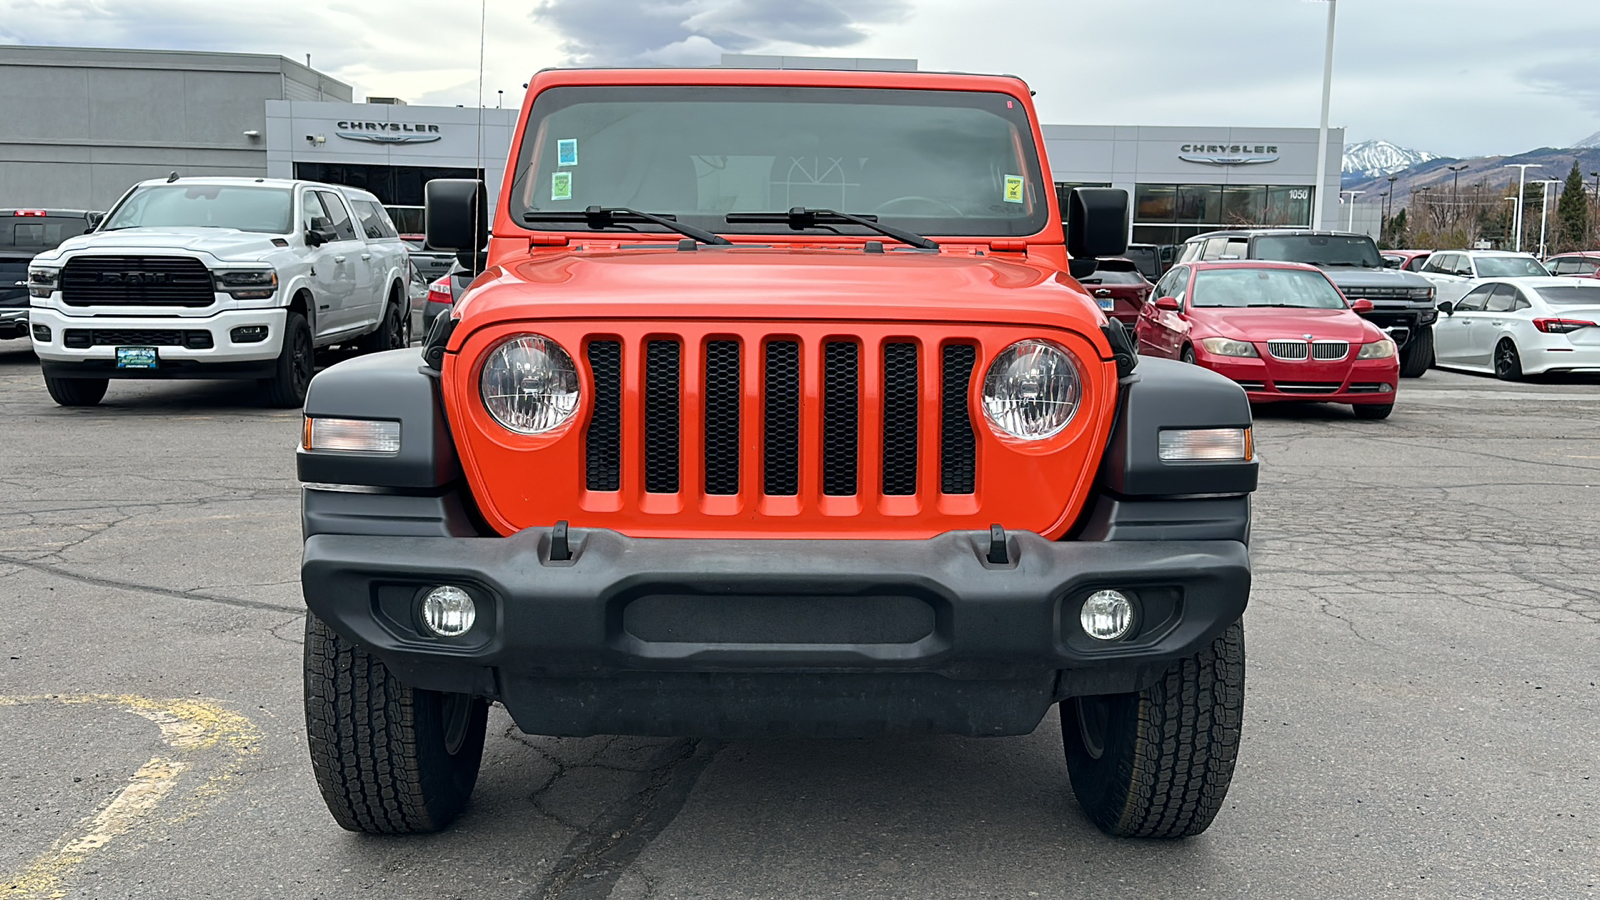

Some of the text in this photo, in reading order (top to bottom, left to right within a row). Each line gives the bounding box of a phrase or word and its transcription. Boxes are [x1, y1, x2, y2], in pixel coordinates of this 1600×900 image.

[337, 121, 440, 132] CHRYSLER
[1180, 144, 1278, 154] CHRYSLER
[1288, 189, 1308, 200] 1050
